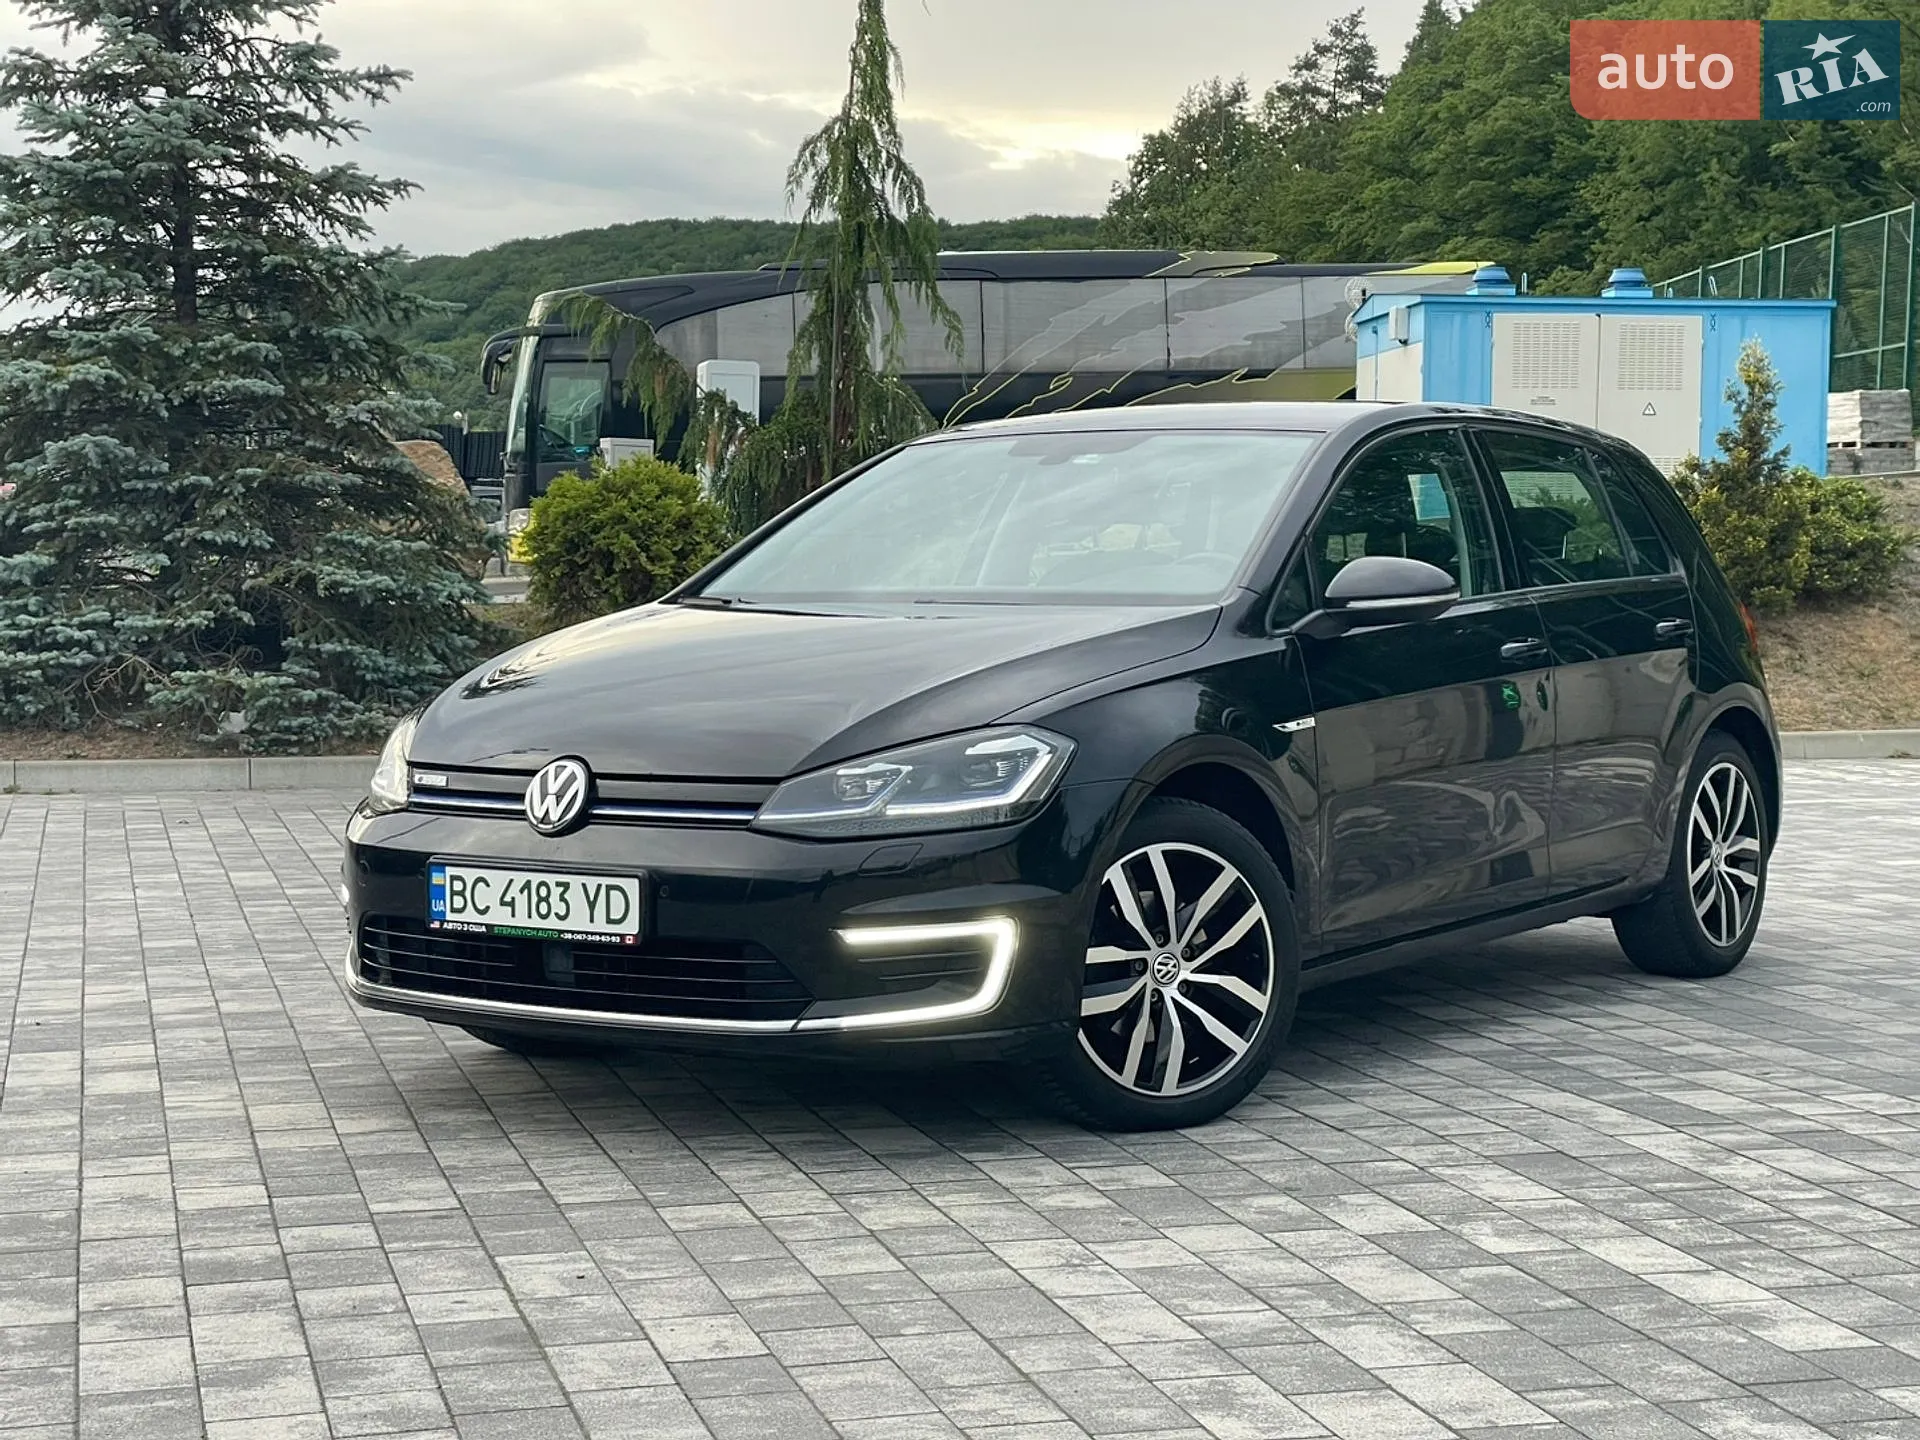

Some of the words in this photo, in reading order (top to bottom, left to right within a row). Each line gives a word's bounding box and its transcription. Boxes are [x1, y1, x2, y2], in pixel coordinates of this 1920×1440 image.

[432, 900, 445, 911] UA
[450, 874, 491, 916] BC
[499, 878, 571, 921] 4183
[581, 882, 631, 925] YD
